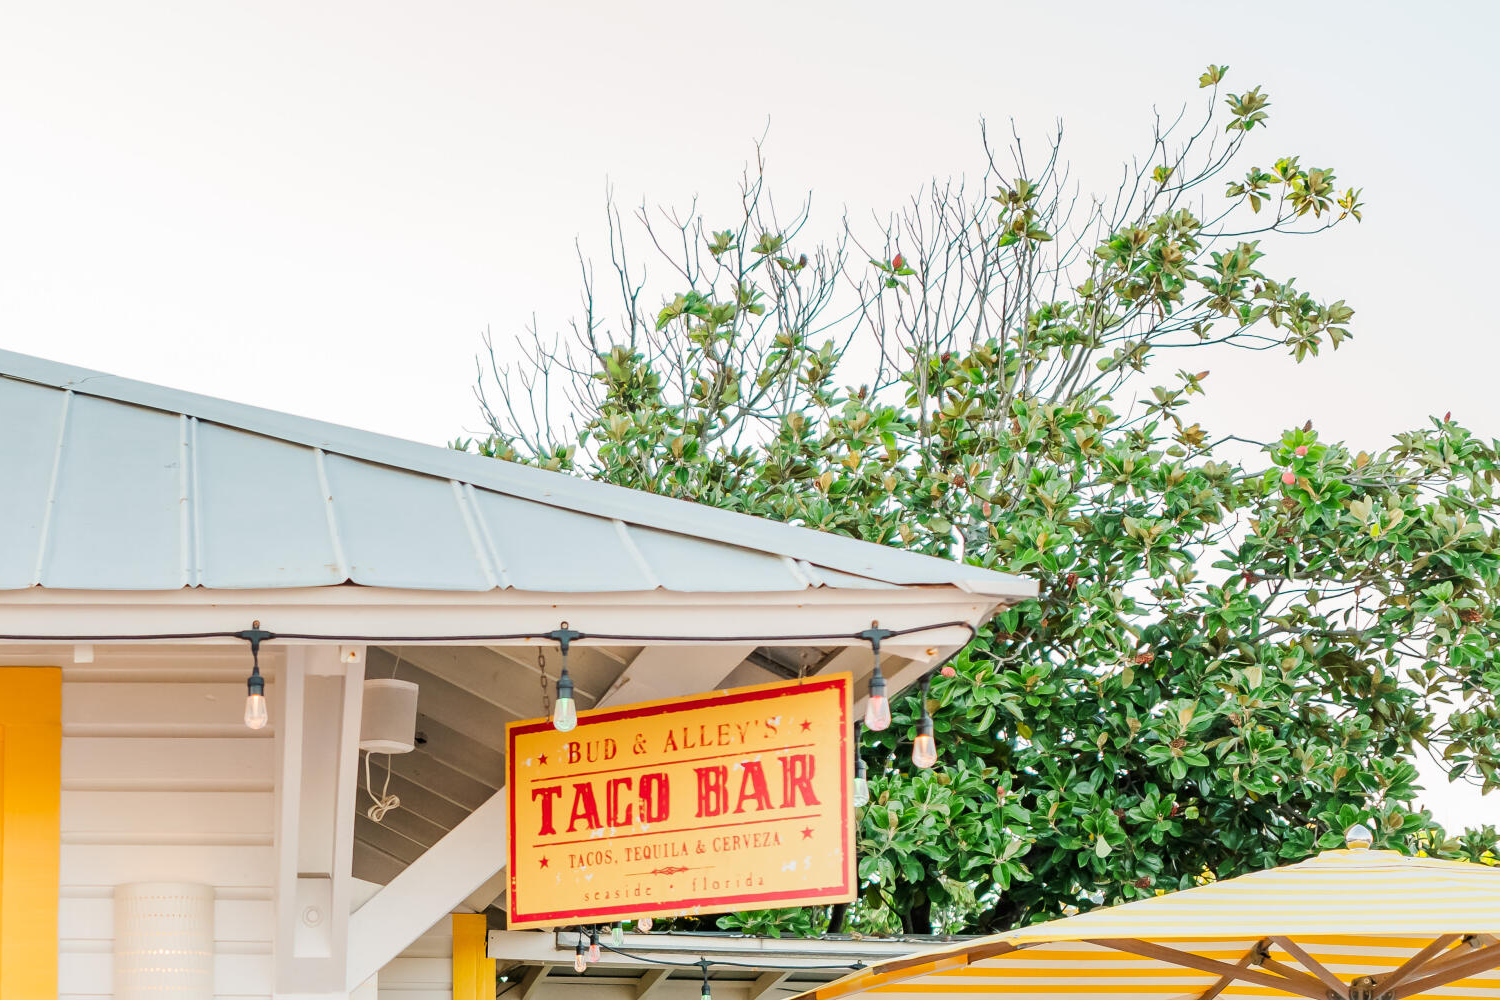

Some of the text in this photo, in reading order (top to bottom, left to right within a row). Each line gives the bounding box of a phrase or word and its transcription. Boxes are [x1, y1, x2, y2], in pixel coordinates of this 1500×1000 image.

[568, 717, 779, 764] BUD & ALLEY'S
[531, 753, 822, 836] TACO BAR
[568, 832, 781, 868] TACOS, TEQUILA & CERVEZA
[584, 872, 764, 902] seaside florida
